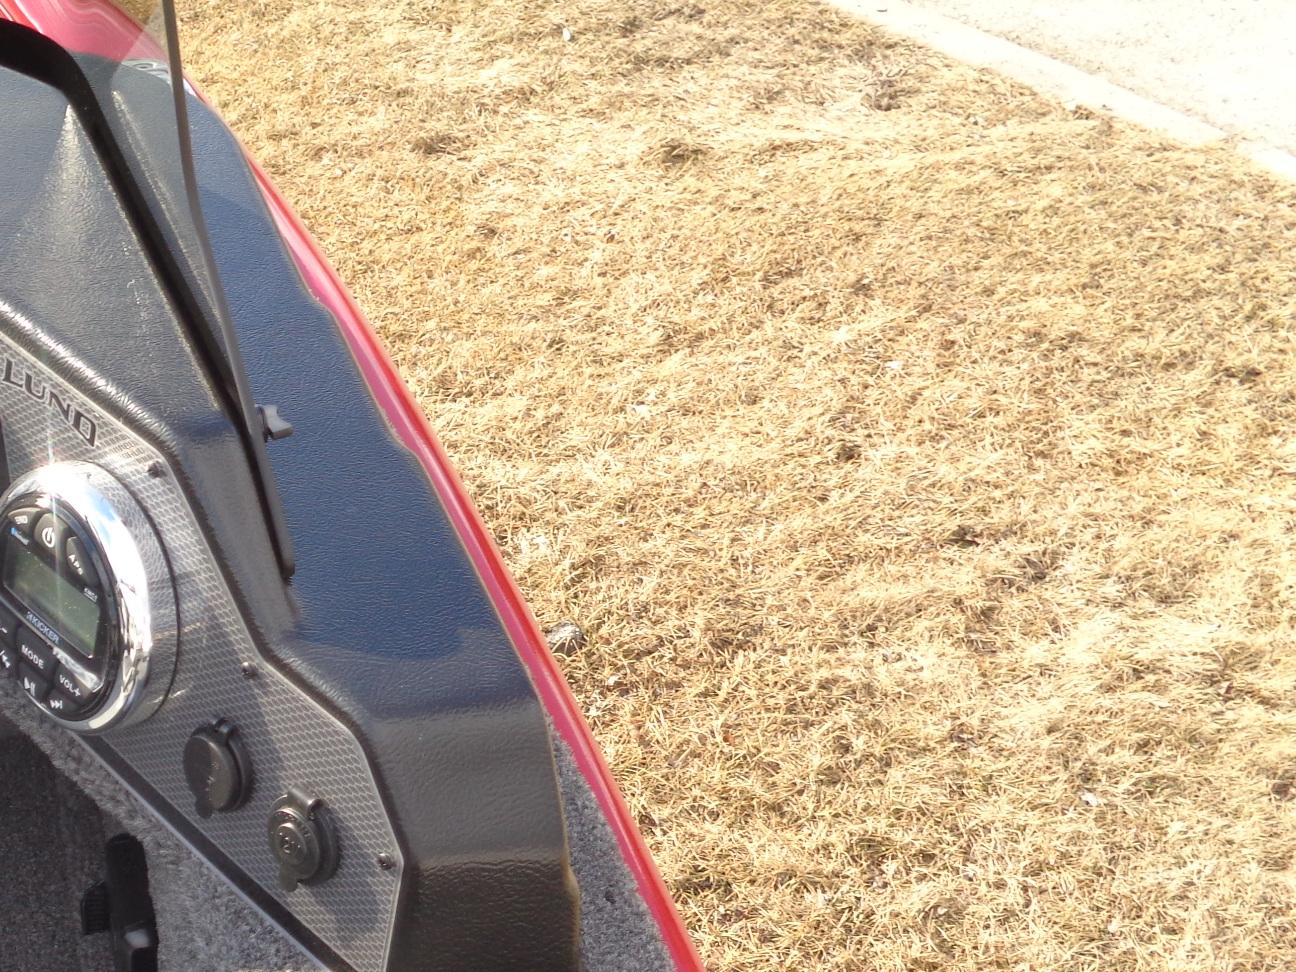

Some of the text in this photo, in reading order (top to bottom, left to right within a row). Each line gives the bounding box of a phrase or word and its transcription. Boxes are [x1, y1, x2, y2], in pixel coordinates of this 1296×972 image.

[2, 358, 98, 448] LUND
[30, 614, 60, 645] KICKER
[21, 644, 44, 669] MODE
